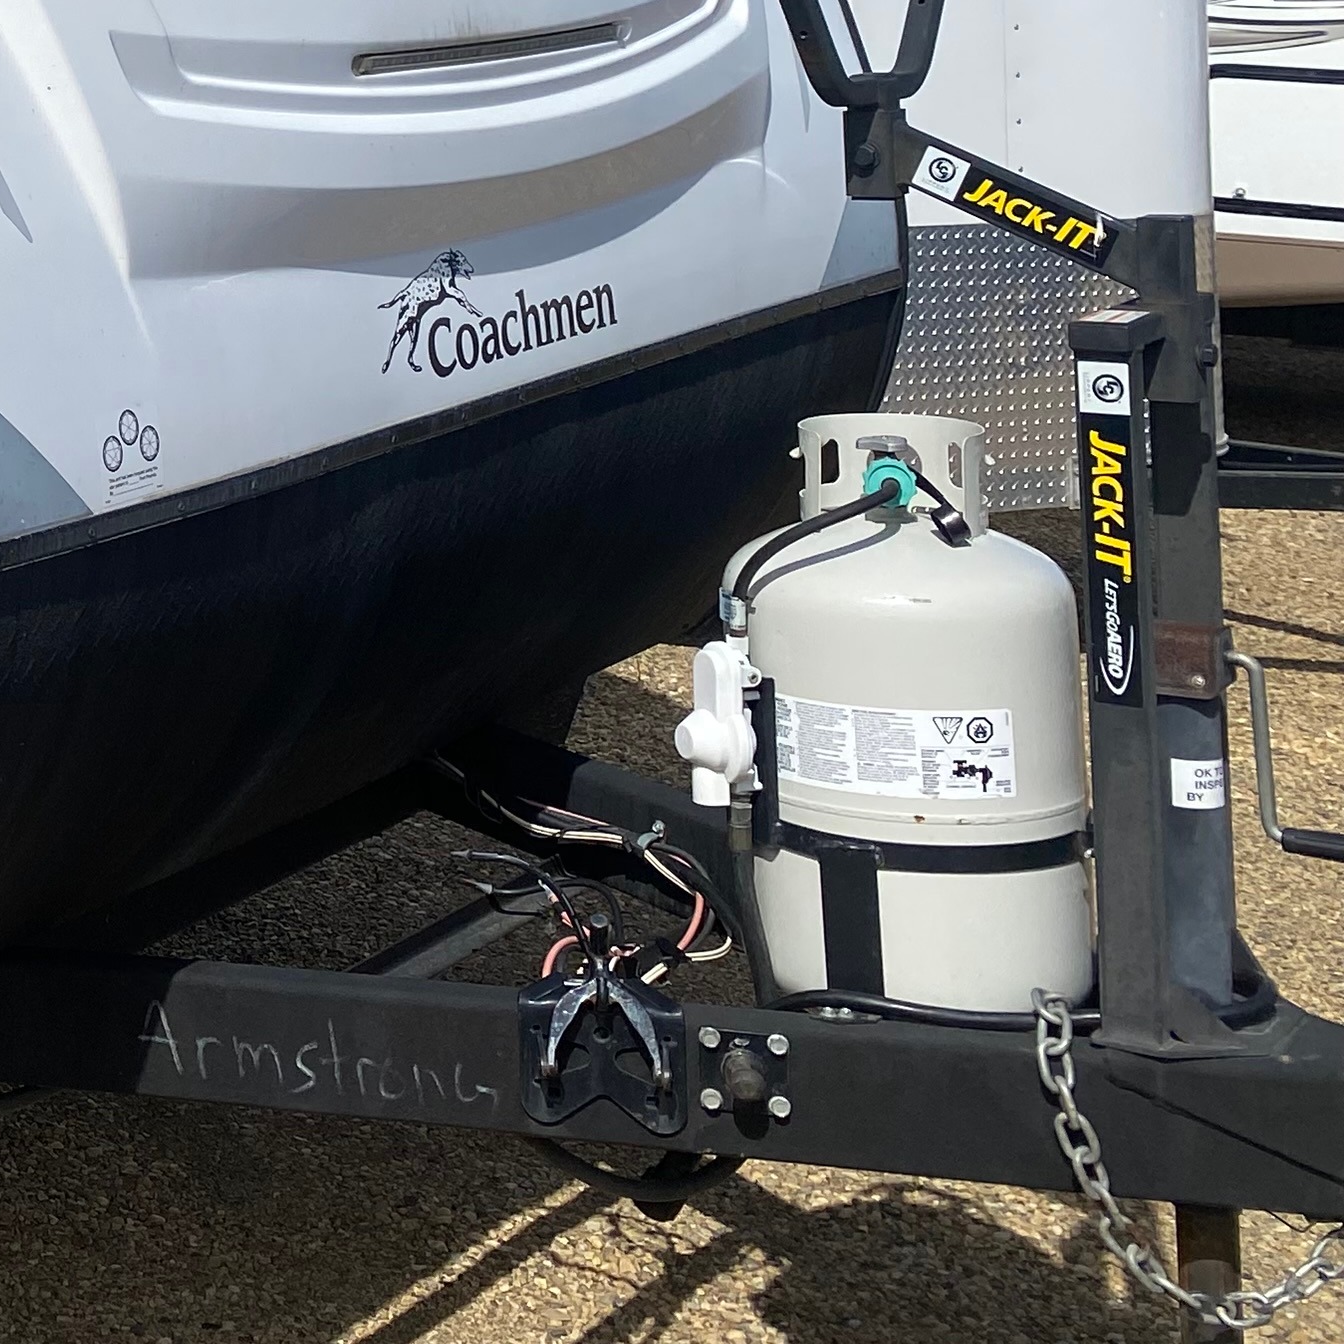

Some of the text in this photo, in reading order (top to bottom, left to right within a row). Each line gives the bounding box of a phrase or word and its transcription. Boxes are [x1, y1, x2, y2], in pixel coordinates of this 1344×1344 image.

[962, 178, 1099, 250] JACK-IT
[428, 283, 618, 378] Coachmen
[1194, 768, 1212, 778] OK
[1187, 792, 1204, 802] BY
